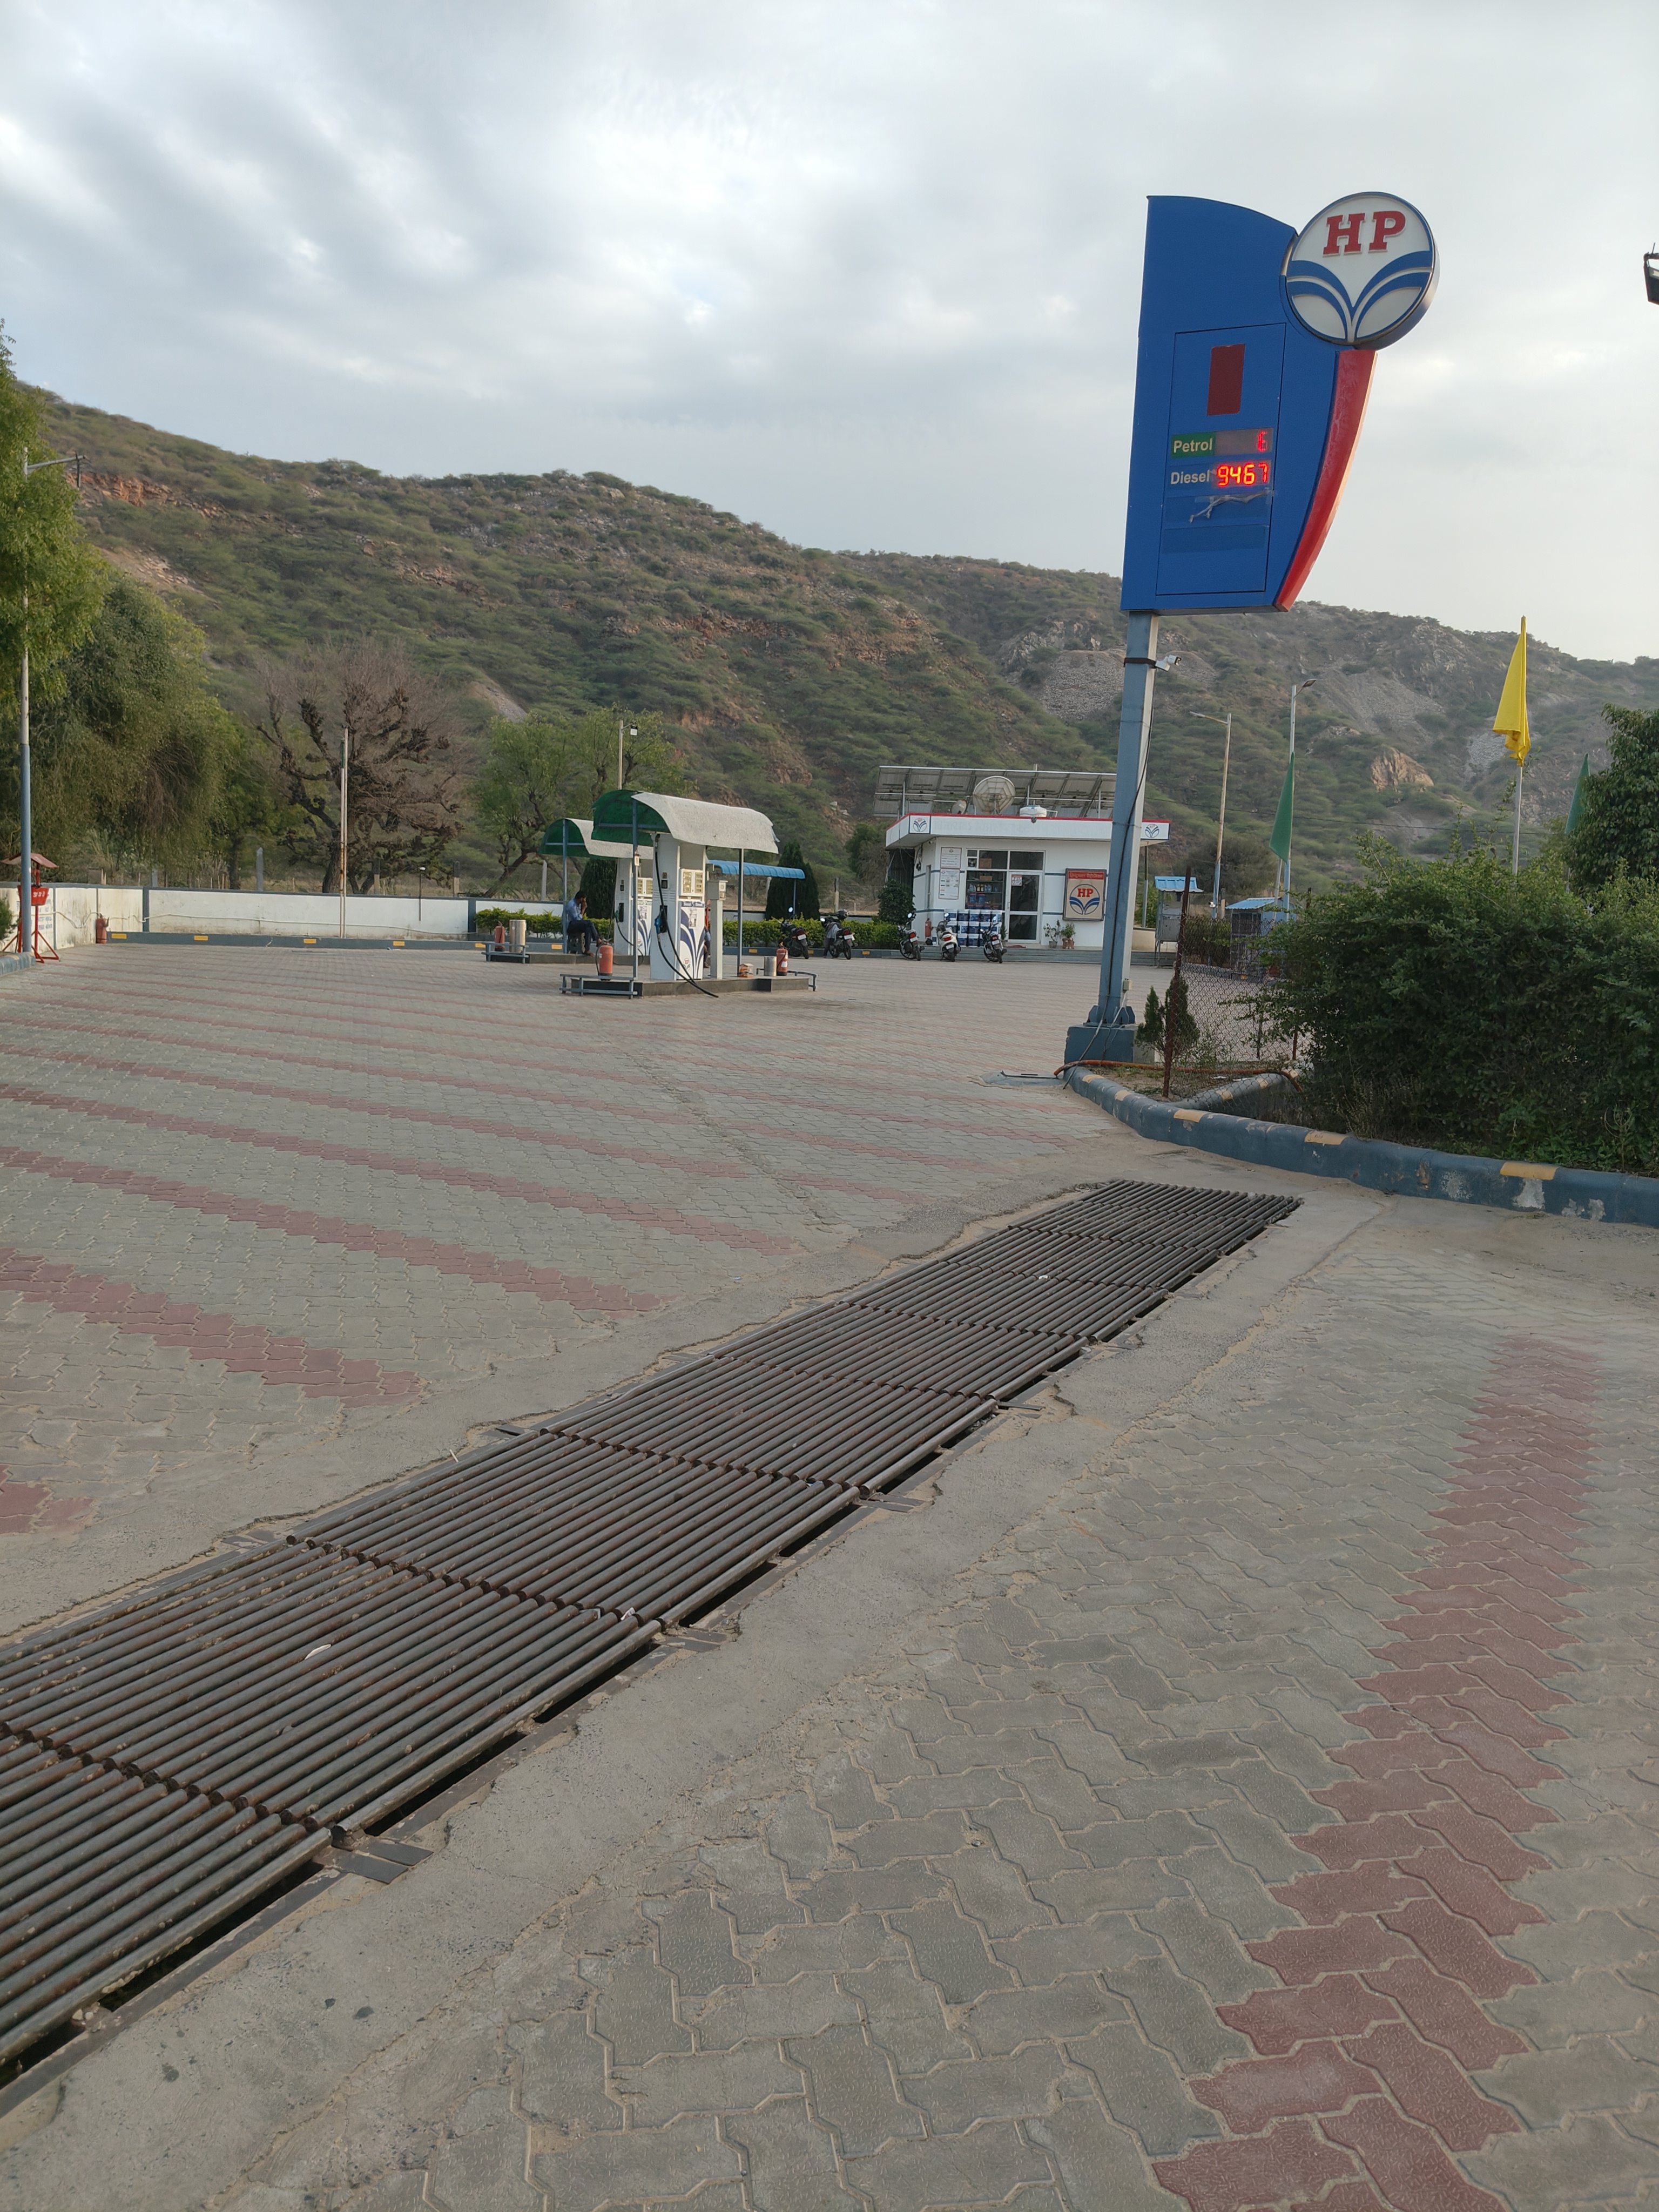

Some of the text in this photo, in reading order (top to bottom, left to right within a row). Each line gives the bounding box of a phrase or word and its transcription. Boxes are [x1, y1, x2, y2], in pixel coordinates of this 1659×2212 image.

[1323, 210, 1406, 257] HP
[1173, 438, 1213, 454] Petrol
[1170, 463, 1269, 487] Diesel 9467
[1077, 888, 1094, 898] HP
